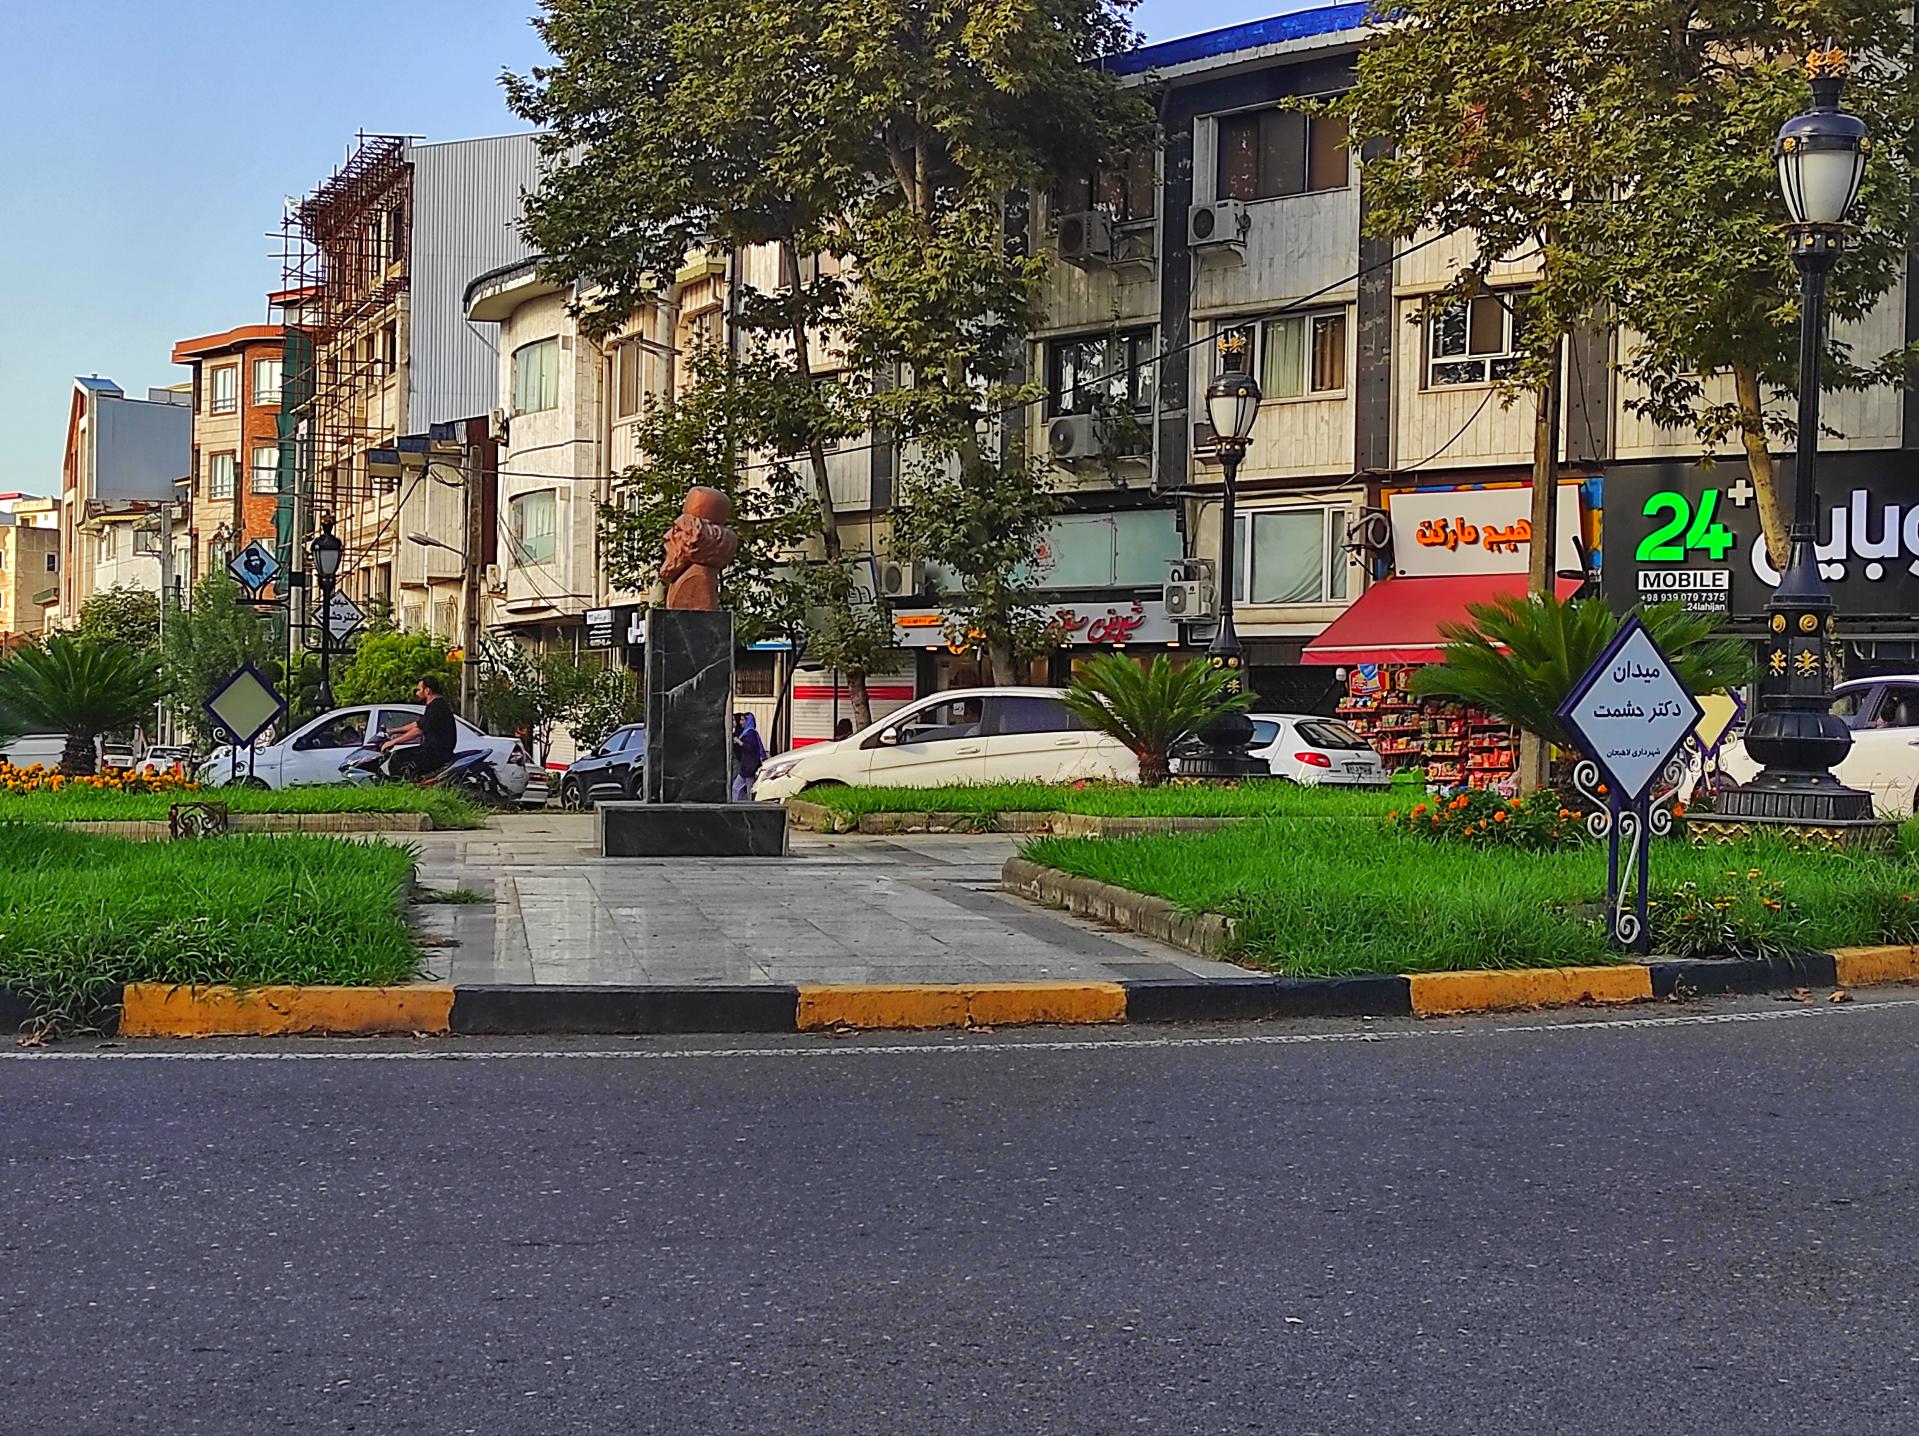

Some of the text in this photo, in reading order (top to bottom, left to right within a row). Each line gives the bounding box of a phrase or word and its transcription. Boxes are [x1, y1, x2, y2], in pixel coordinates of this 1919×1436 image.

[1643, 572, 1724, 588] MOBILE
[1640, 592, 1726, 602] +98 939 079 7375
[1087, 599, 1147, 645] شیرینی
[1613, 660, 1660, 684] میدان
[1593, 700, 1682, 723] دکتر حشمت
[1606, 747, 1661, 759] شهرداری لاهیجان
